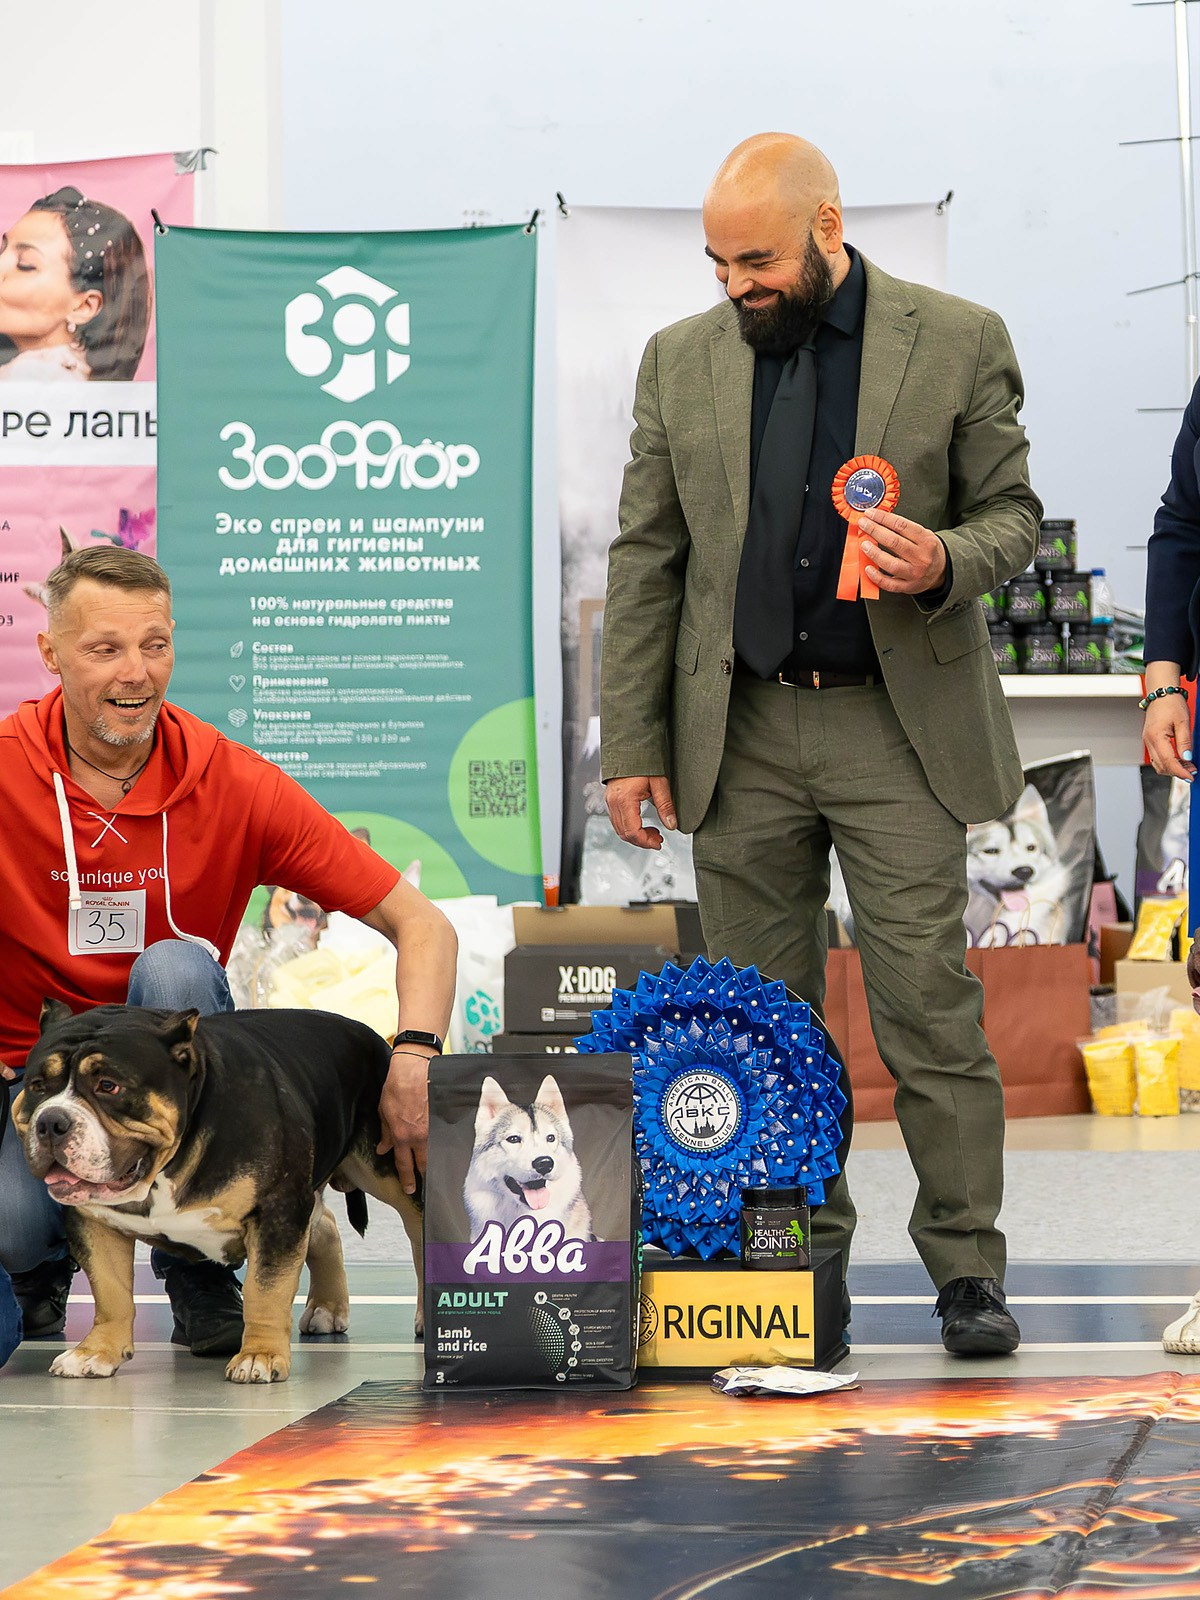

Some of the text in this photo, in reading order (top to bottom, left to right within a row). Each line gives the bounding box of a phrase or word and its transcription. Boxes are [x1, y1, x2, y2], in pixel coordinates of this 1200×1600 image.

[215, 513, 485, 538] Эко спреи и шампуни
[276, 537, 423, 555] для гигиены
[219, 556, 481, 575] домашних животных
[250, 596, 454, 613] 100% натуральные средства
[252, 613, 451, 629] на основе гидролата пихты
[252, 642, 294, 654] Состав
[252, 675, 329, 688] Применение
[253, 709, 312, 721] Упаковка
[50, 867, 165, 888] so unique you
[85, 910, 125, 945] 35
[668, 1075, 734, 1107] AMERICAN BULLY
[673, 1124, 733, 1147] KENNEL CLUB
[754, 1229, 786, 1237] HEALTHY
[750, 1236, 797, 1250] JOINTS
[437, 1291, 509, 1308] ADULT
[663, 1304, 810, 1340] RIGINAL
[437, 1326, 472, 1339] Lamb
[437, 1340, 488, 1352] and rice
[436, 1371, 445, 1384] 3
